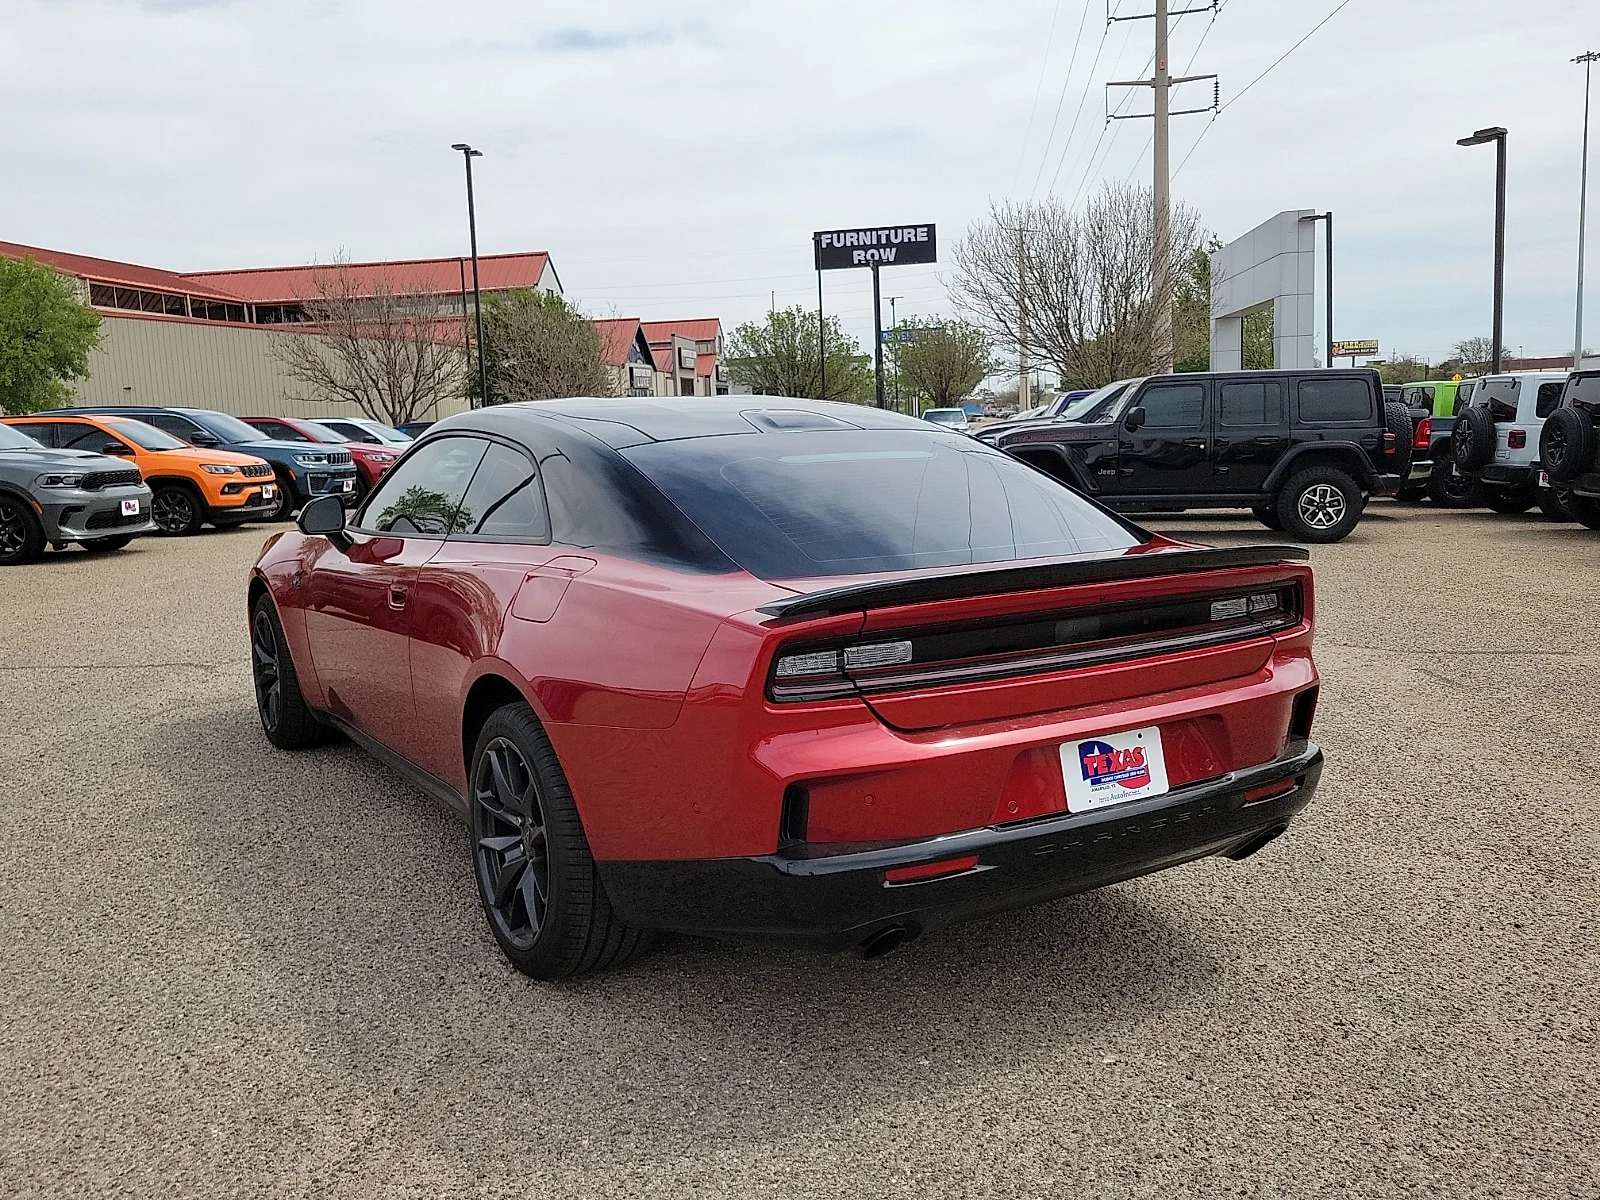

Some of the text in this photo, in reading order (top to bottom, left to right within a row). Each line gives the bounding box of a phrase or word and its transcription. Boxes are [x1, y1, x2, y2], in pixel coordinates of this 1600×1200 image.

[820, 227, 929, 249] FURNITURE
[852, 247, 897, 264] ROW
[1097, 468, 1116, 476] Jeep
[1083, 746, 1145, 776] TEXAS
